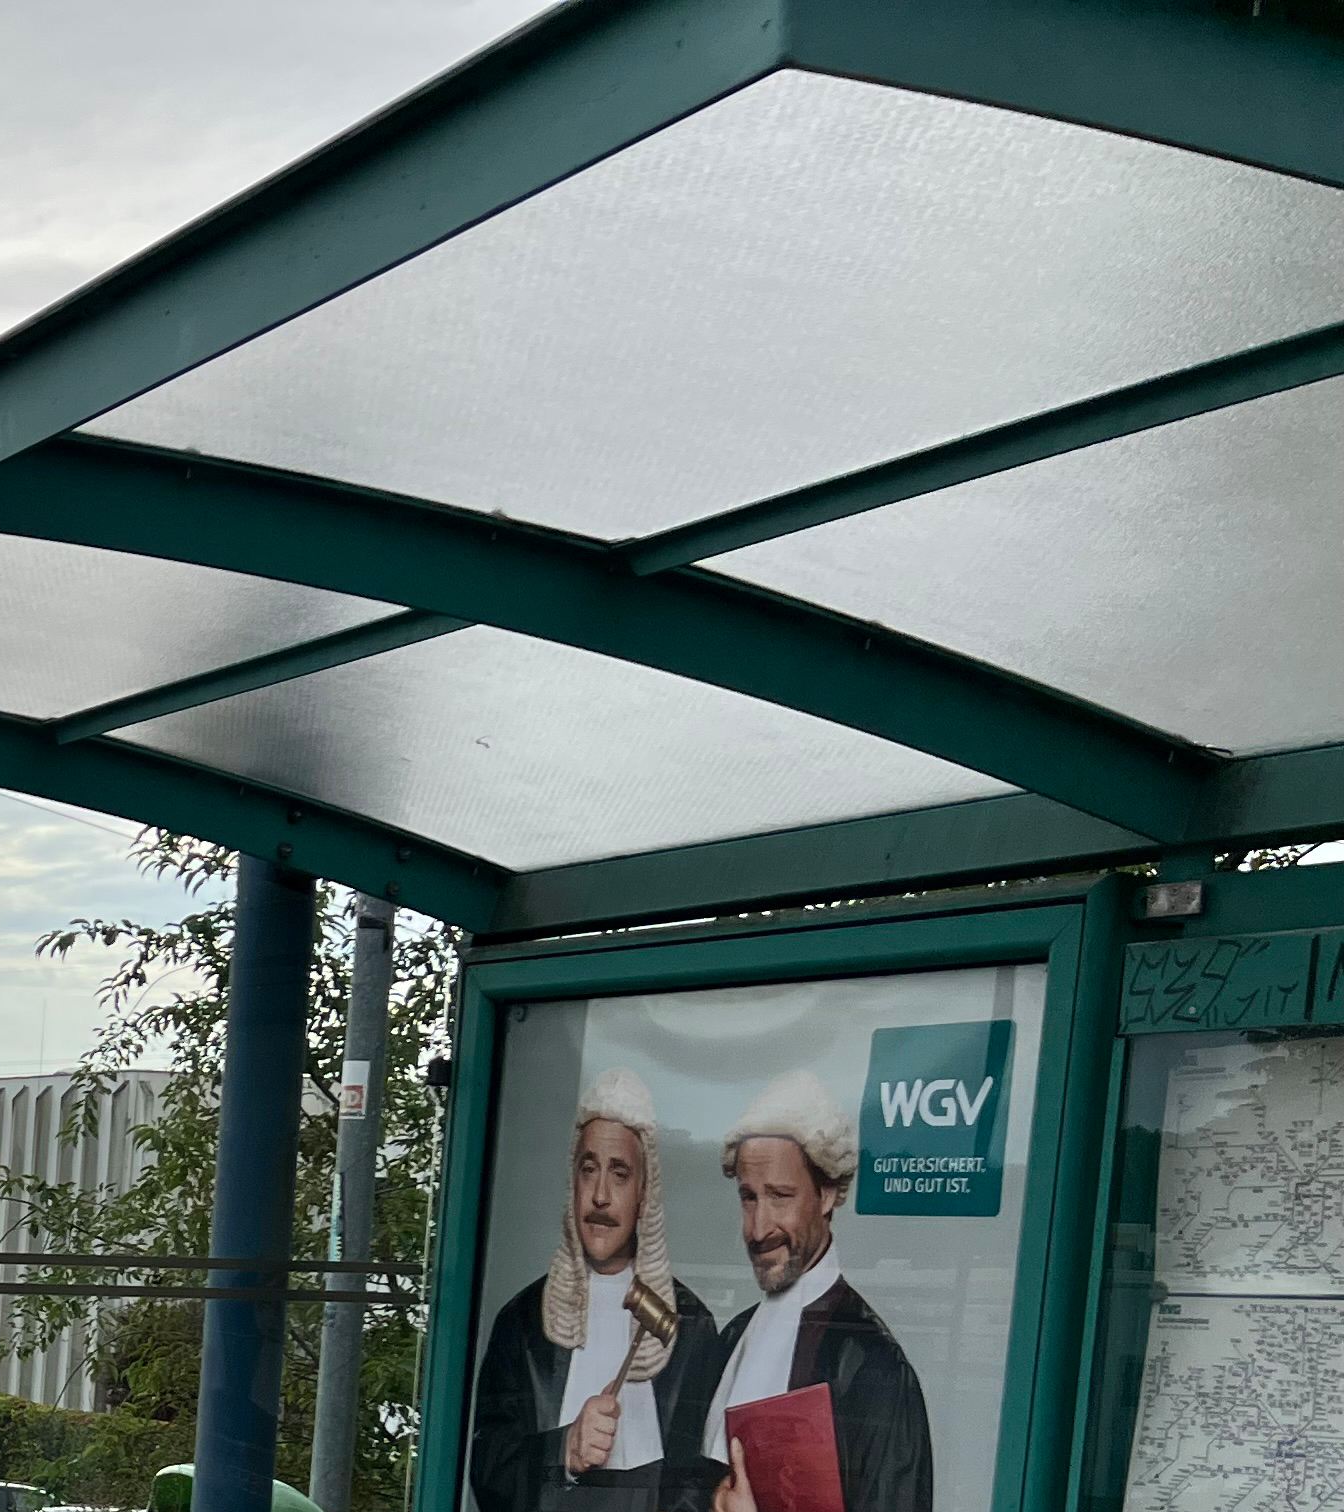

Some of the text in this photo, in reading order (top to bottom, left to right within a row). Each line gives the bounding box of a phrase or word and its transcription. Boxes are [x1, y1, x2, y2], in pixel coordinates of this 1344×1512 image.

[880, 1075, 994, 1128] WGV
[873, 1157, 987, 1173] GUT VERSICHERT.
[884, 1178, 971, 1193] UND GUT IST.
